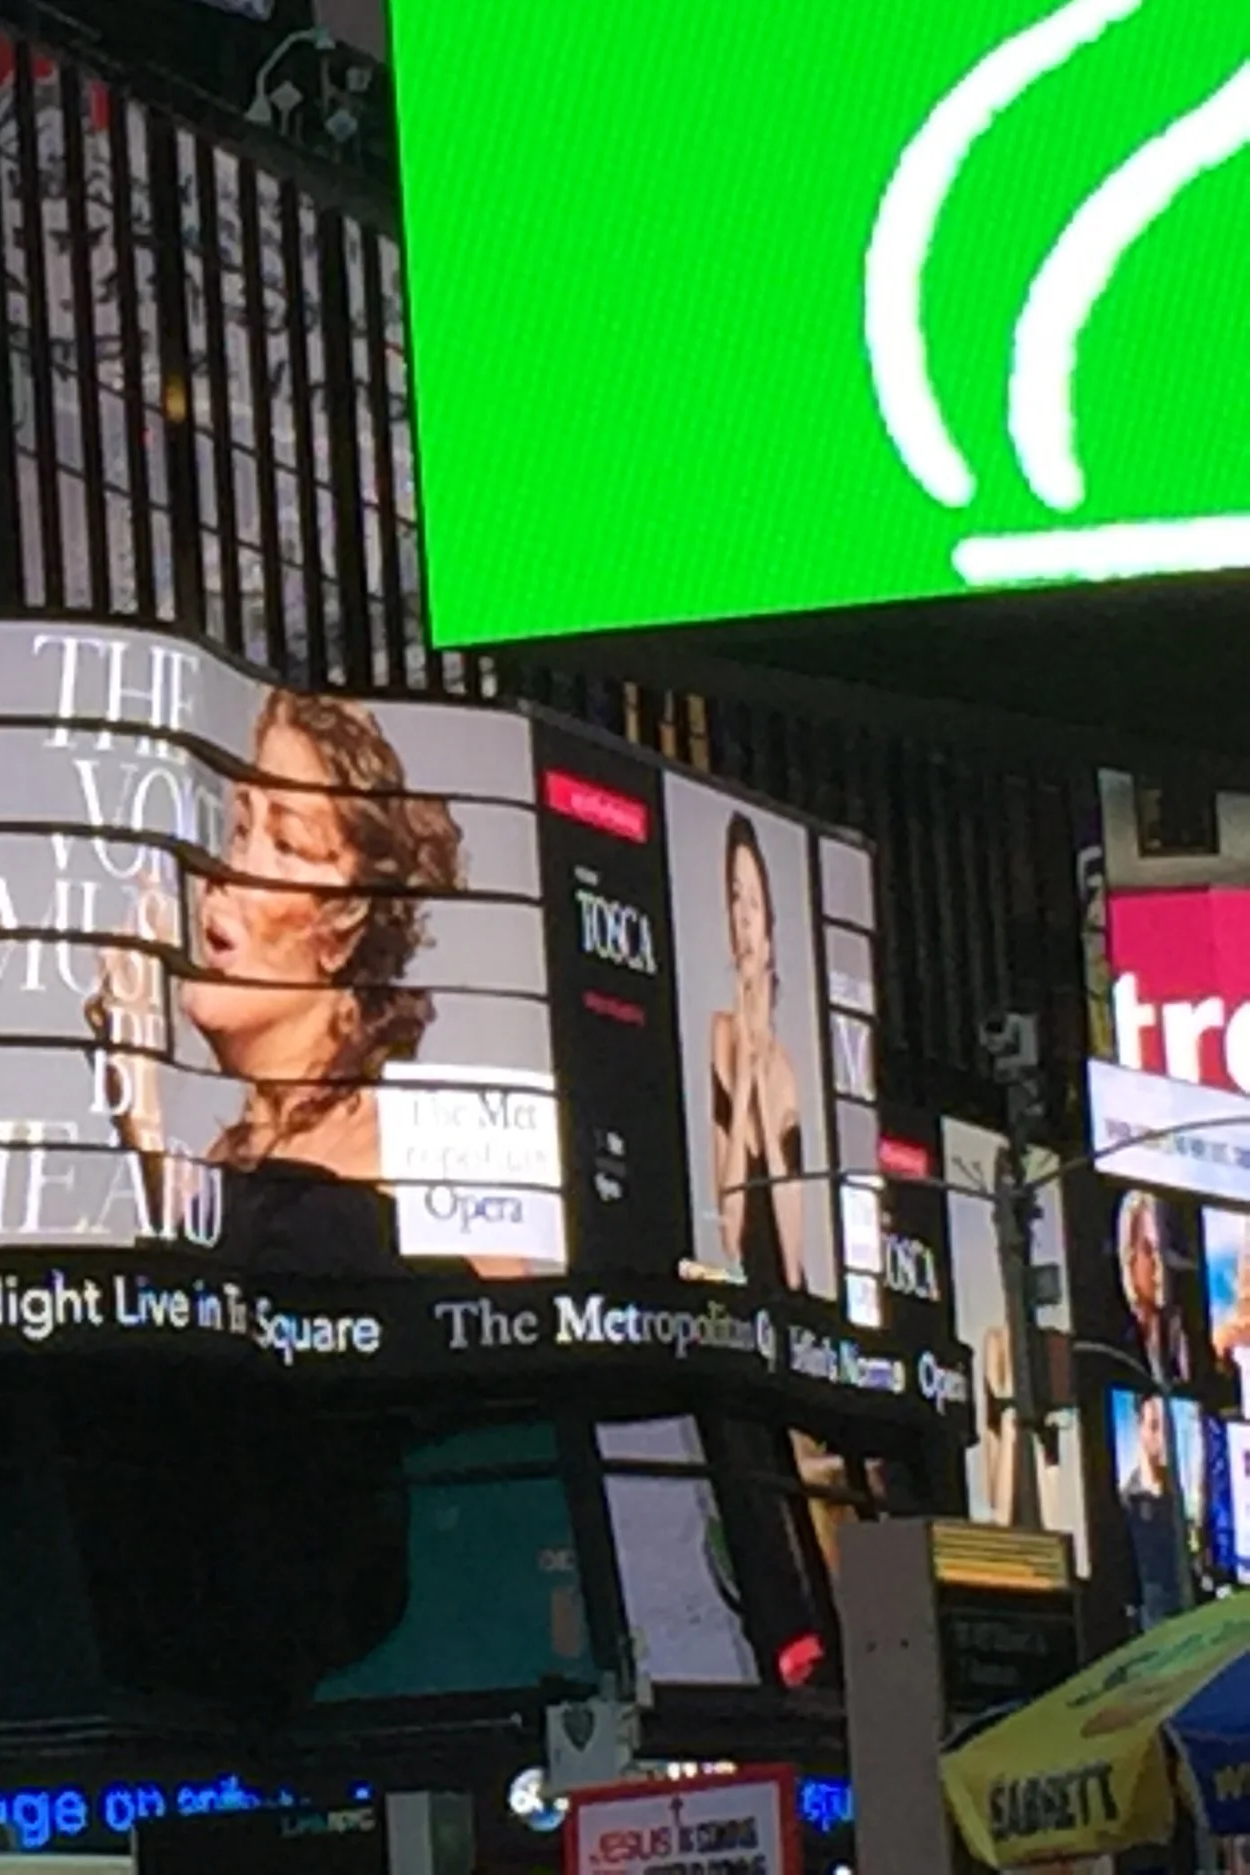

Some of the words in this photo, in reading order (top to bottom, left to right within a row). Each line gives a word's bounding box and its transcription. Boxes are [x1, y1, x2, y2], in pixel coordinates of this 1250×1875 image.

[33, 634, 199, 764] THE
[574, 887, 658, 976] TOSCA
[424, 1184, 525, 1235] Opera
[112, 1275, 190, 1328] Live
[253, 1296, 381, 1365] Square
[433, 1297, 540, 1349] The
